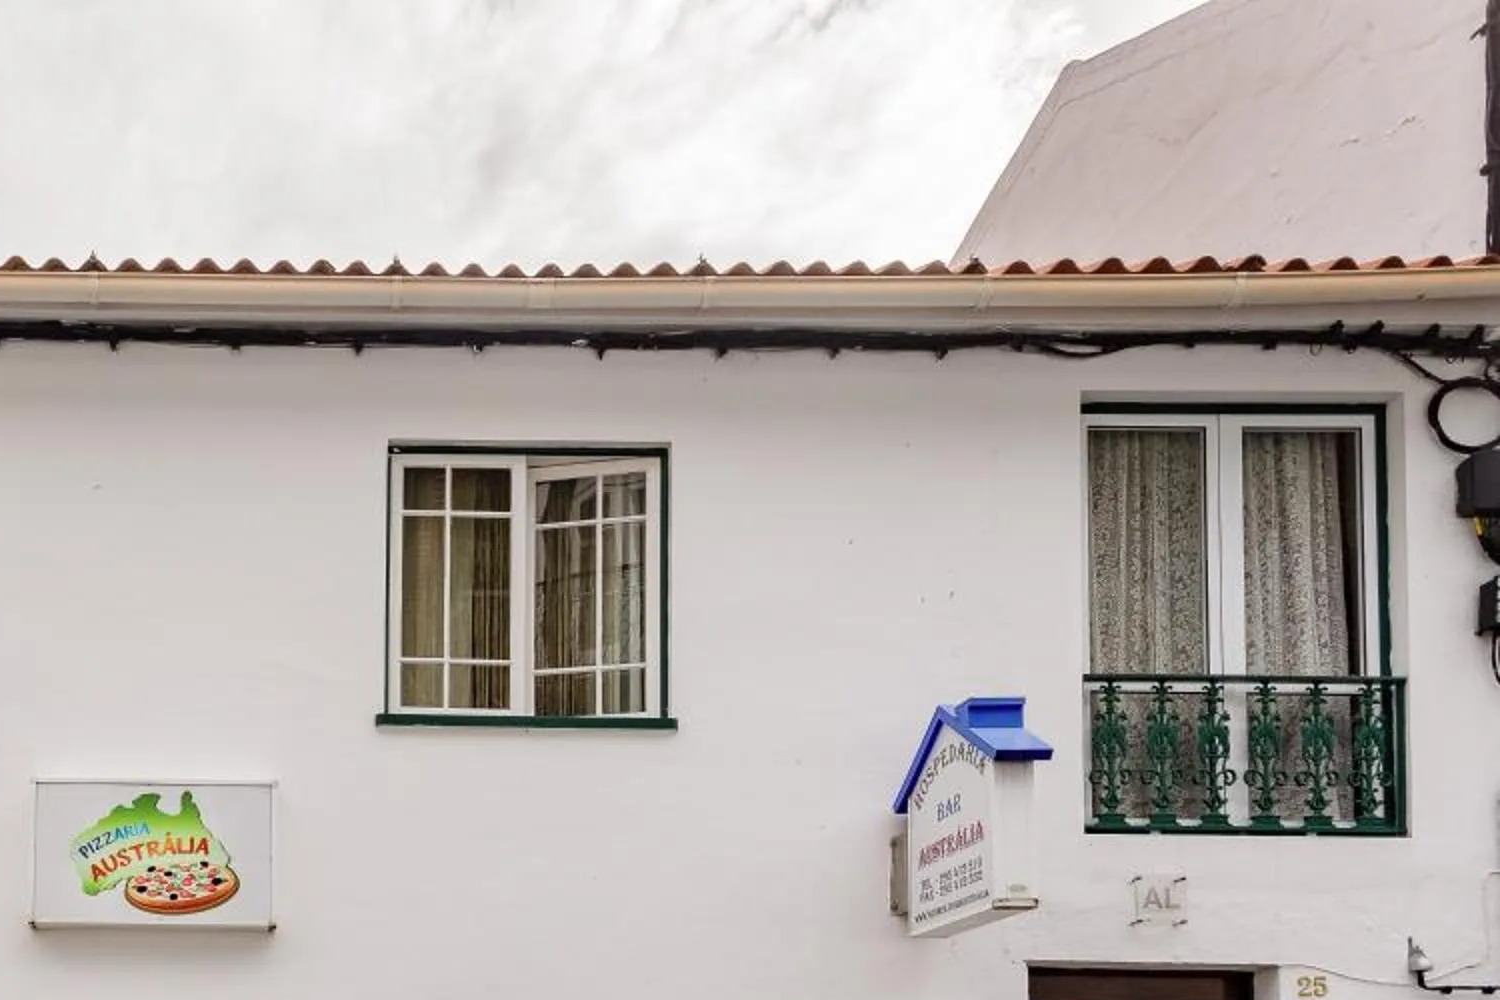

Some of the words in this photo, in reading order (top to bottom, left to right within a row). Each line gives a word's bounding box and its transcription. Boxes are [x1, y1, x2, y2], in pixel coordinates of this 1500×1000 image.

[913, 742, 987, 811] HOSPEDARIA
[936, 793, 962, 823] BAR
[77, 821, 151, 860] PIZZARIA
[88, 831, 211, 884] AUSTRÁLIA
[918, 820, 986, 869] AUSTRÁLIA
[1143, 886, 1181, 909] AL
[1297, 975, 1329, 998] 25
